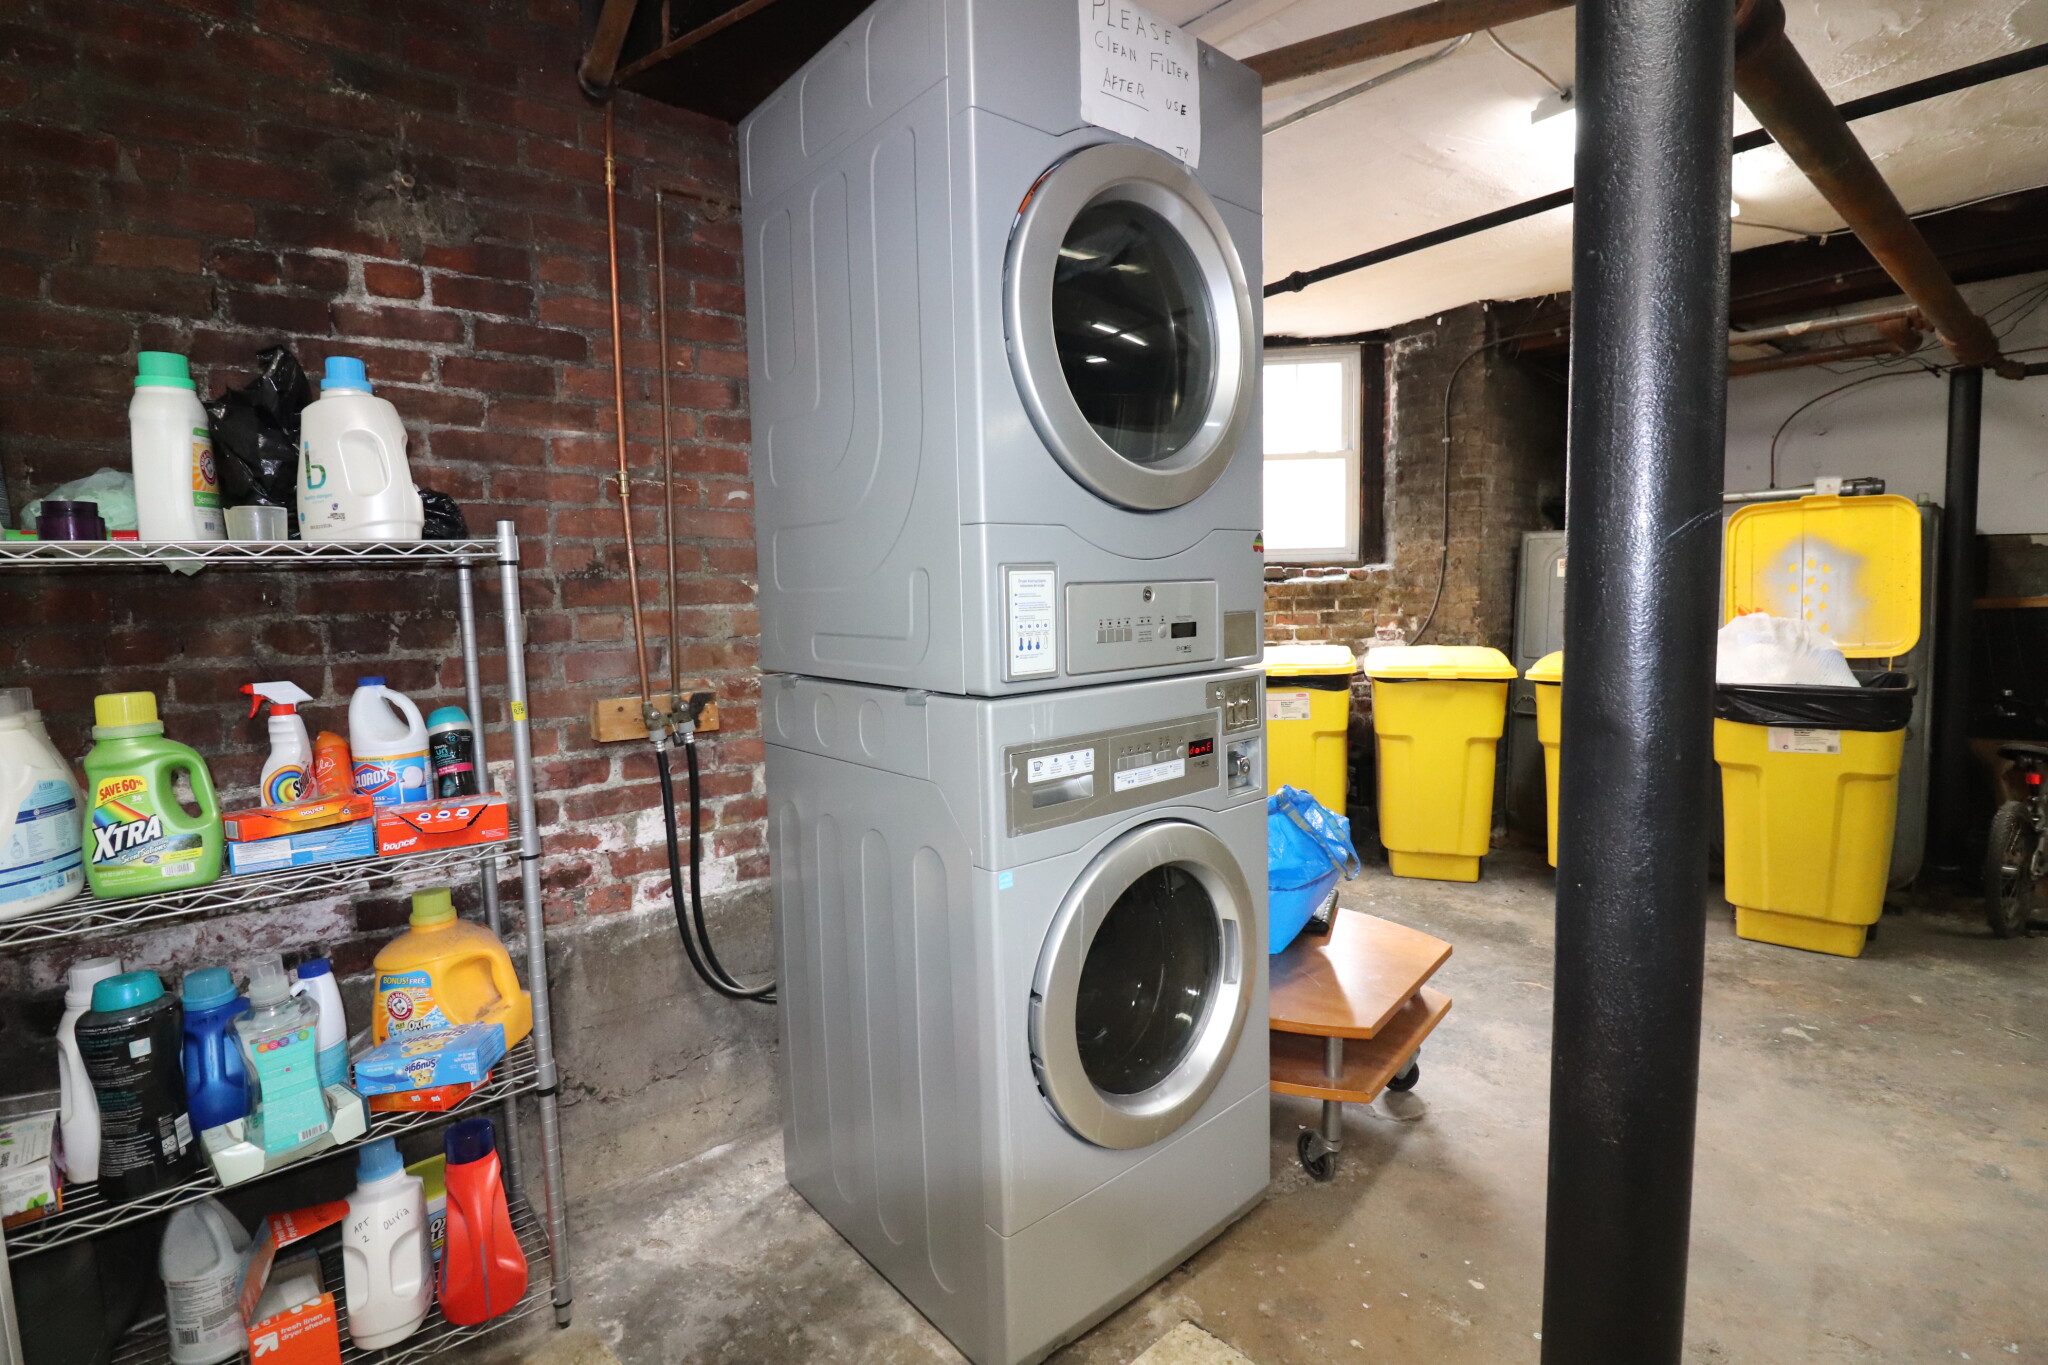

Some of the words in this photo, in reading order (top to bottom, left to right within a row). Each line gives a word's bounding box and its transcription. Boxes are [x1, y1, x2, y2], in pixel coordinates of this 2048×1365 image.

[1092, 0, 1172, 45] PLEASE
[1102, 67, 1145, 99] AFTER
[1165, 98, 1187, 116] USE
[99, 782, 121, 801] SAVE
[121, 778, 143, 792] 60%
[300, 806, 325, 816] bounce
[92, 814, 164, 865] XTRA
[383, 836, 418, 851] bounce
[383, 976, 409, 985] BONUS!
[404, 1058, 437, 1073] Snuggle
[353, 1216, 370, 1235] APT
[362, 1234, 370, 1244] 2
[280, 1321, 303, 1335] fresh
[303, 1313, 323, 1326] linen
[281, 1327, 303, 1341] dryer
[304, 1316, 331, 1332] sheets
